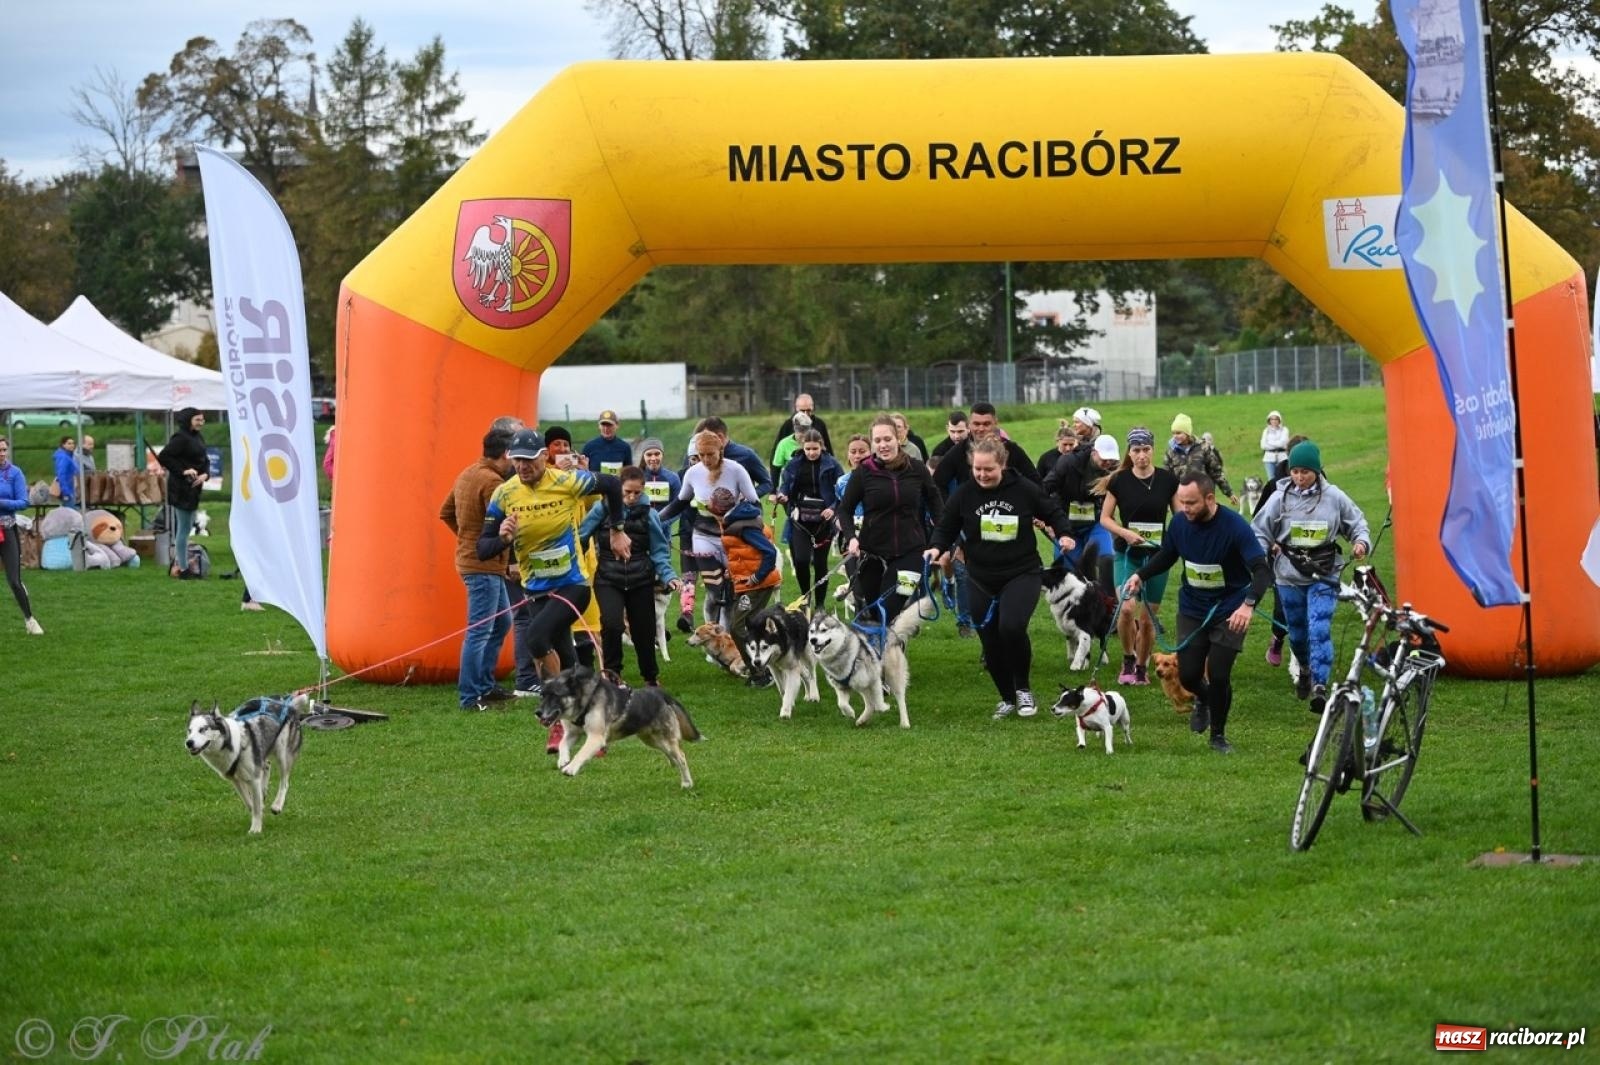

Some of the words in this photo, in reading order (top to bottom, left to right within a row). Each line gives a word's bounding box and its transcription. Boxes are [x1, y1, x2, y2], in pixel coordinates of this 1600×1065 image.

[728, 143, 911, 182] MIASTO
[928, 130, 1181, 181] RACIBÓRZ
[1343, 224, 1400, 267] Rac
[995, 523, 1003, 533] 3
[1303, 529, 1316, 538] 37
[543, 559, 560, 570] 34
[1196, 572, 1212, 581] 12
